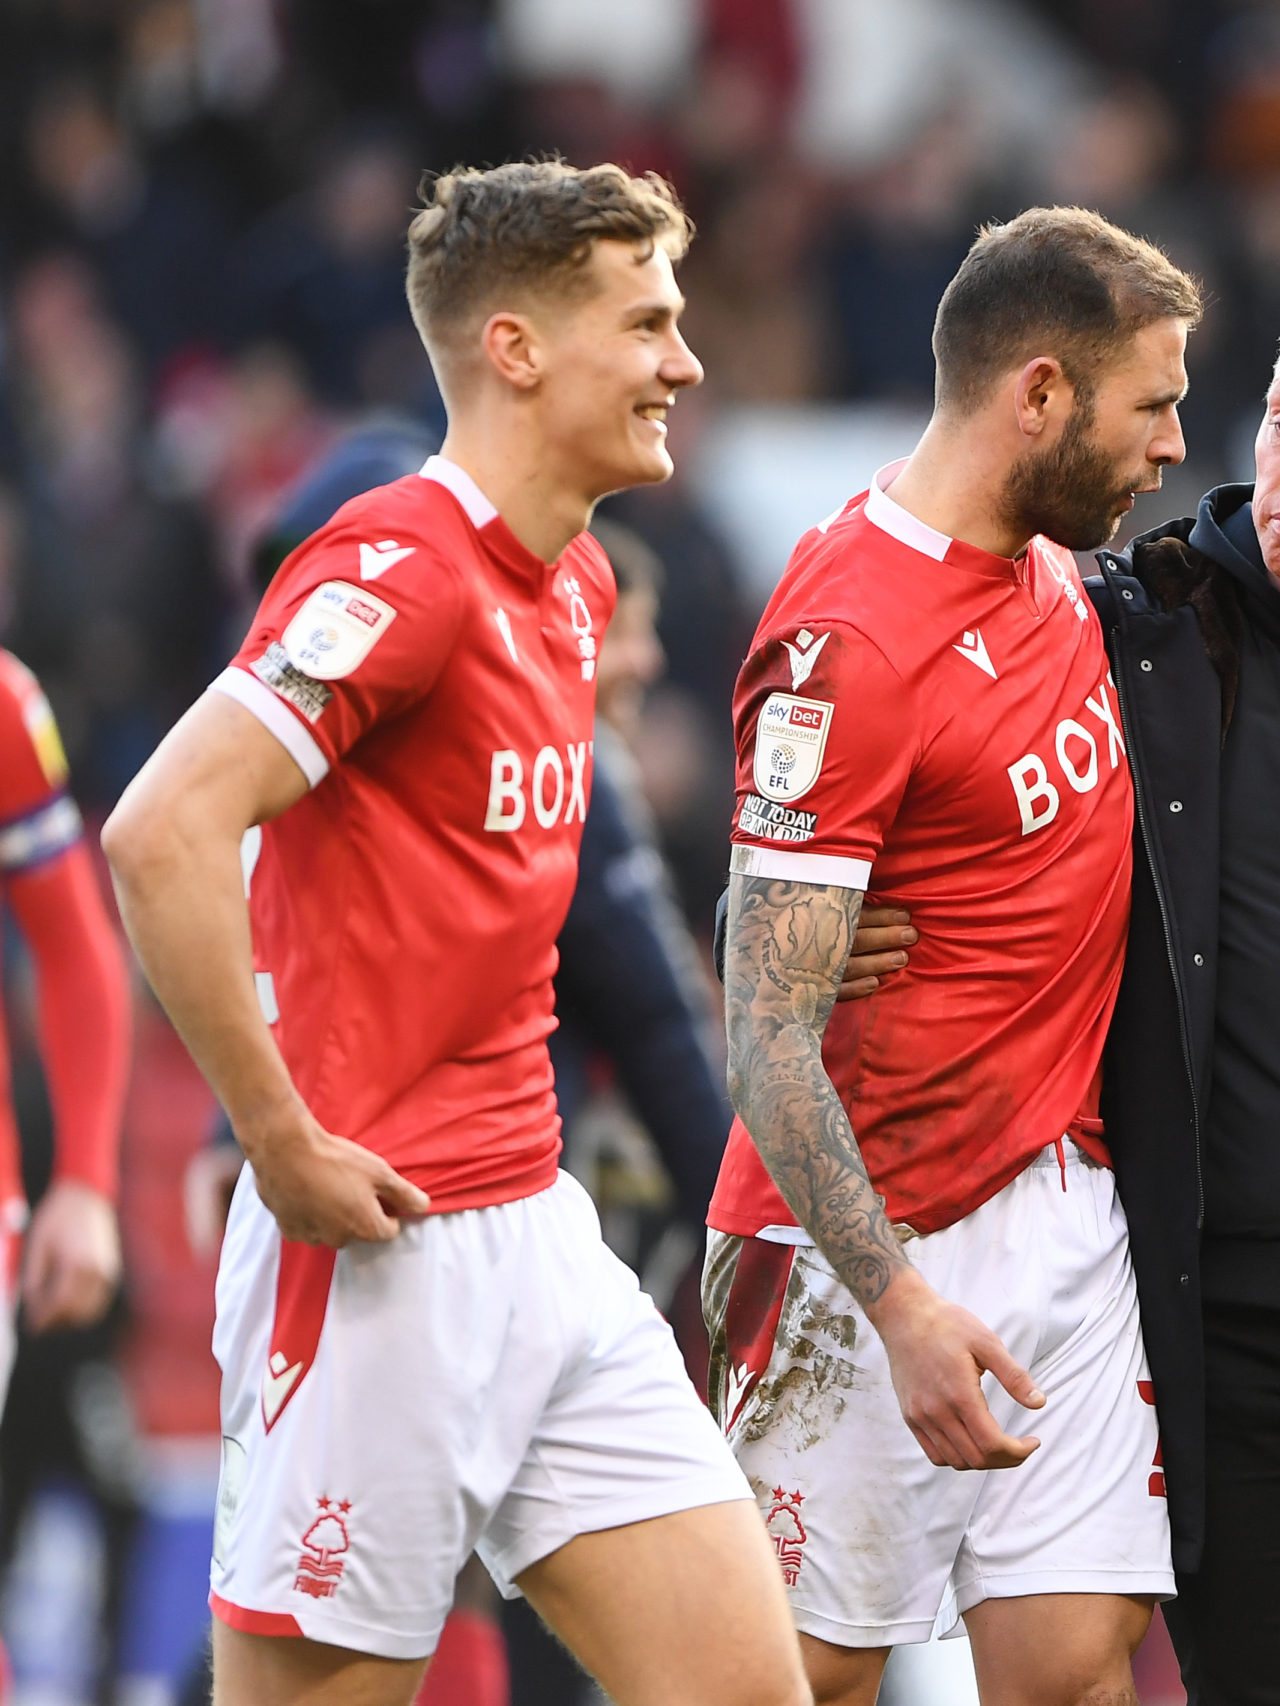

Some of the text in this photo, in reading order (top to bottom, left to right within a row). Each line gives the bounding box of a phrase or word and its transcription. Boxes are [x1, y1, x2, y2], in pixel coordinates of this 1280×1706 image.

[767, 703, 820, 725] sky bet
[763, 724, 819, 741] CHAMPIONSHIP
[1007, 668, 1128, 837] BOX
[483, 740, 594, 832] BOX
[769, 775, 790, 790] EFL
[744, 793, 817, 830] NOT TODAY
[752, 818, 780, 838] ANY
[782, 827, 814, 842] DAY
